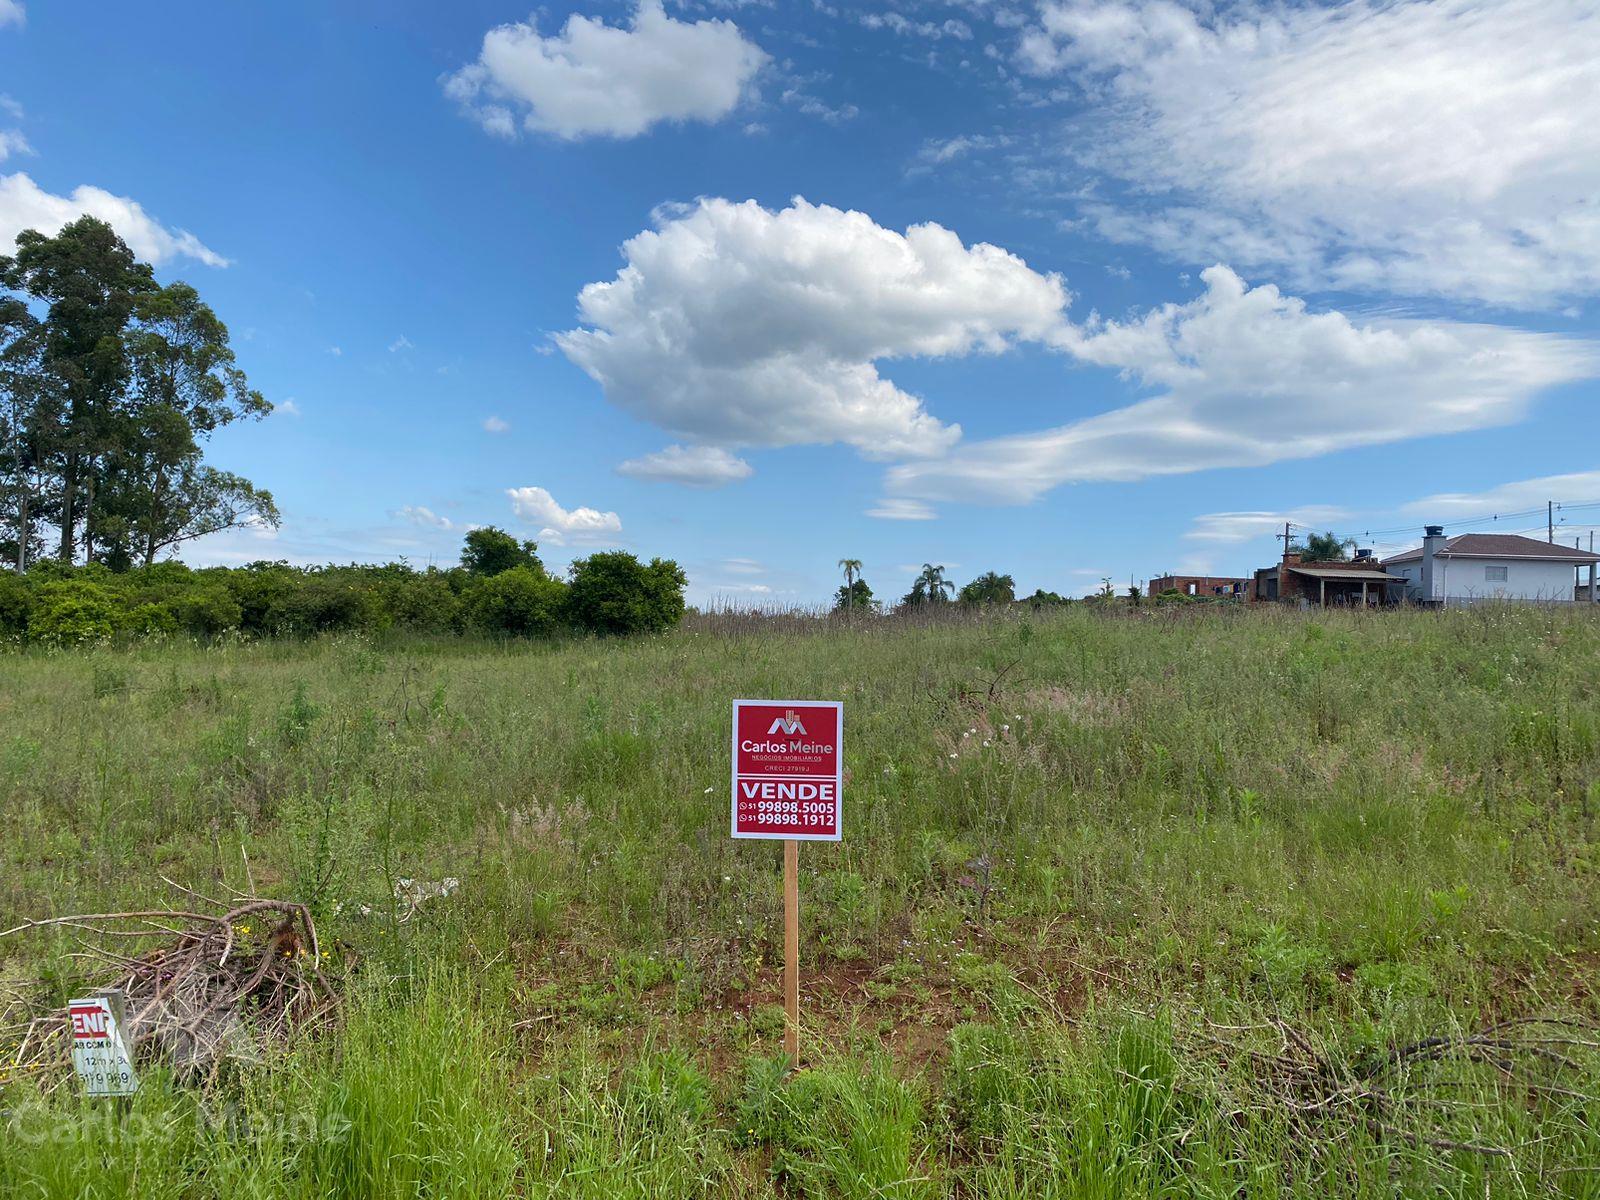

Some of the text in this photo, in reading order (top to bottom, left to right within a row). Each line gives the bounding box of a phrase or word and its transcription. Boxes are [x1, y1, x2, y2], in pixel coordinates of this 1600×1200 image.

[741, 740, 833, 754] Carlos Meine
[741, 782, 834, 800] VENDE
[757, 801, 834, 814] 99898.5005
[748, 813, 834, 826] 51 99898.1912
